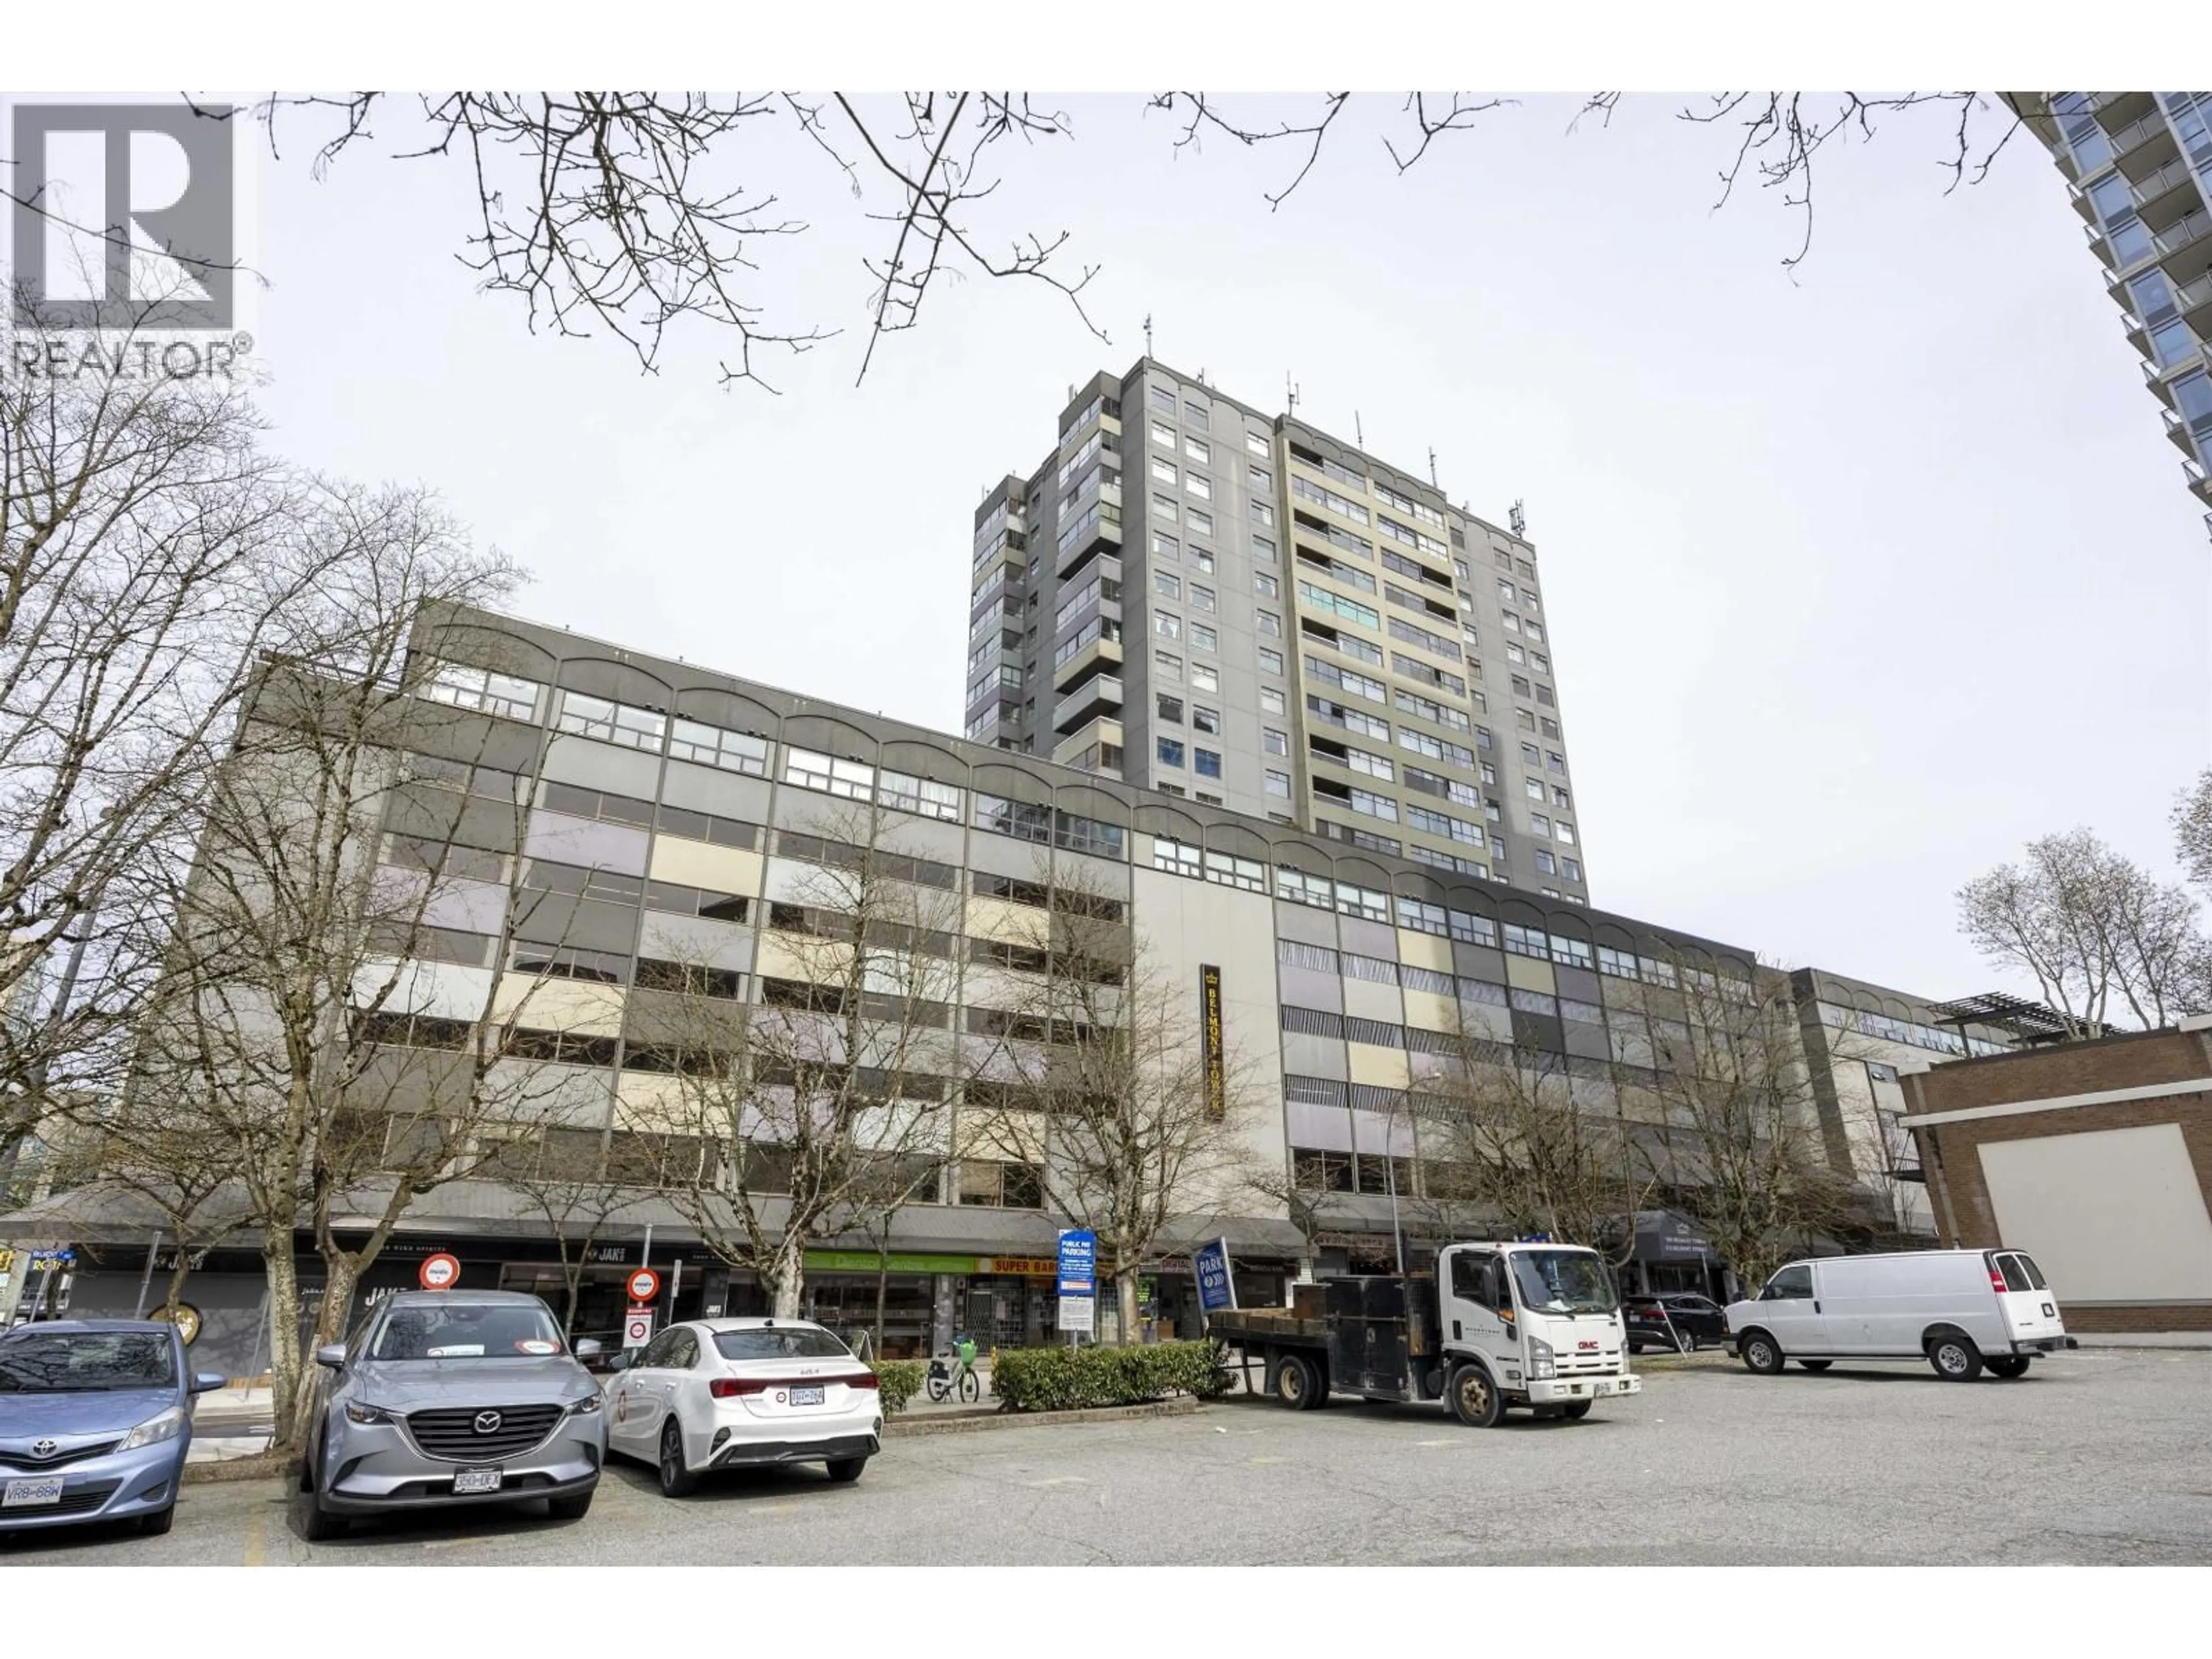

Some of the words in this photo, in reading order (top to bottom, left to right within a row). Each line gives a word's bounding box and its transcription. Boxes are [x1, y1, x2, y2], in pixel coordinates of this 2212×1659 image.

[1209, 988, 1219, 1055] BELMONT
[1062, 1248, 1092, 1256] PARKING
[995, 1260, 1029, 1272] SUPER
[1035, 1261, 1058, 1273] BAR
[1200, 1257, 1223, 1274] PARK
[1578, 1341, 1599, 1350] GMC
